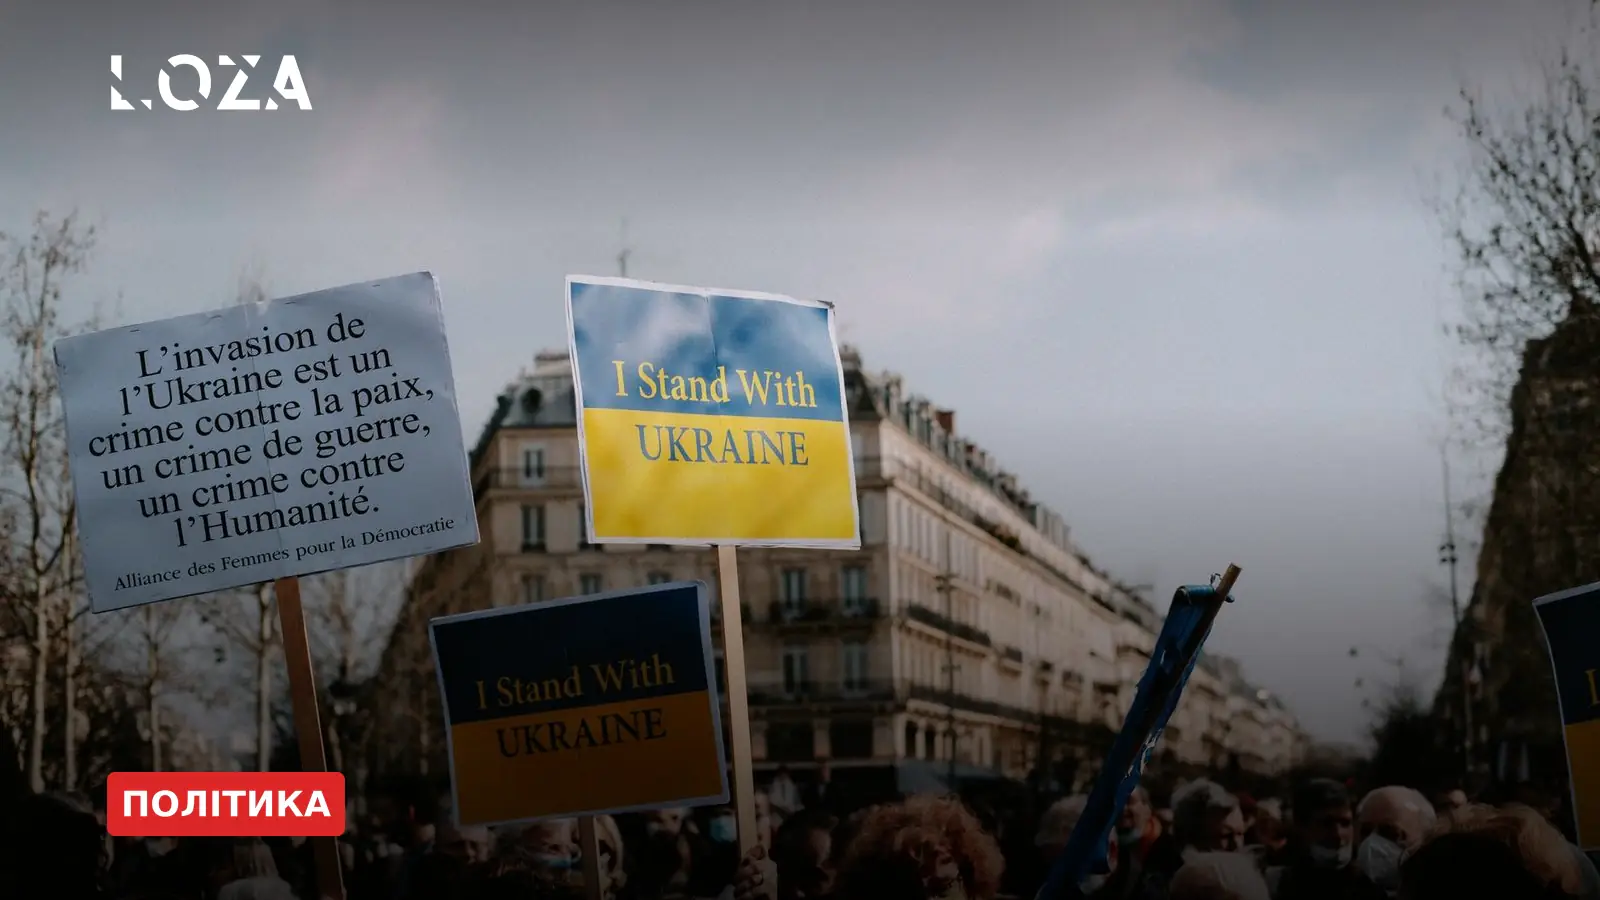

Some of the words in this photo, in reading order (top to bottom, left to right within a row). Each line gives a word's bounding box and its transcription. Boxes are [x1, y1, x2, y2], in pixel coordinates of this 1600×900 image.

[327, 313, 366, 343] de
[294, 353, 341, 383] est
[352, 348, 392, 374] un
[612, 361, 629, 396] I
[637, 362, 730, 404] Stand
[736, 369, 817, 408] With
[88, 422, 184, 457] crime
[195, 399, 301, 435] contre
[313, 388, 343, 417] la
[352, 373, 434, 417] paix,
[101, 464, 144, 490] un
[155, 444, 252, 481] crime
[263, 430, 303, 460] de
[315, 413, 431, 459] guerre,
[634, 424, 809, 467] UKRAINE
[138, 493, 183, 518] un
[192, 473, 289, 510] crime
[300, 449, 405, 486] contre
[114, 567, 181, 591] Alliance
[188, 560, 215, 577] des
[220, 547, 289, 572] Femmes
[296, 539, 335, 560] pour
[341, 534, 356, 550] la
[362, 516, 455, 545] Démocratie
[474, 679, 488, 709] I
[497, 666, 583, 706] Stand
[589, 653, 676, 691] With
[495, 709, 667, 758] UKRAINE
